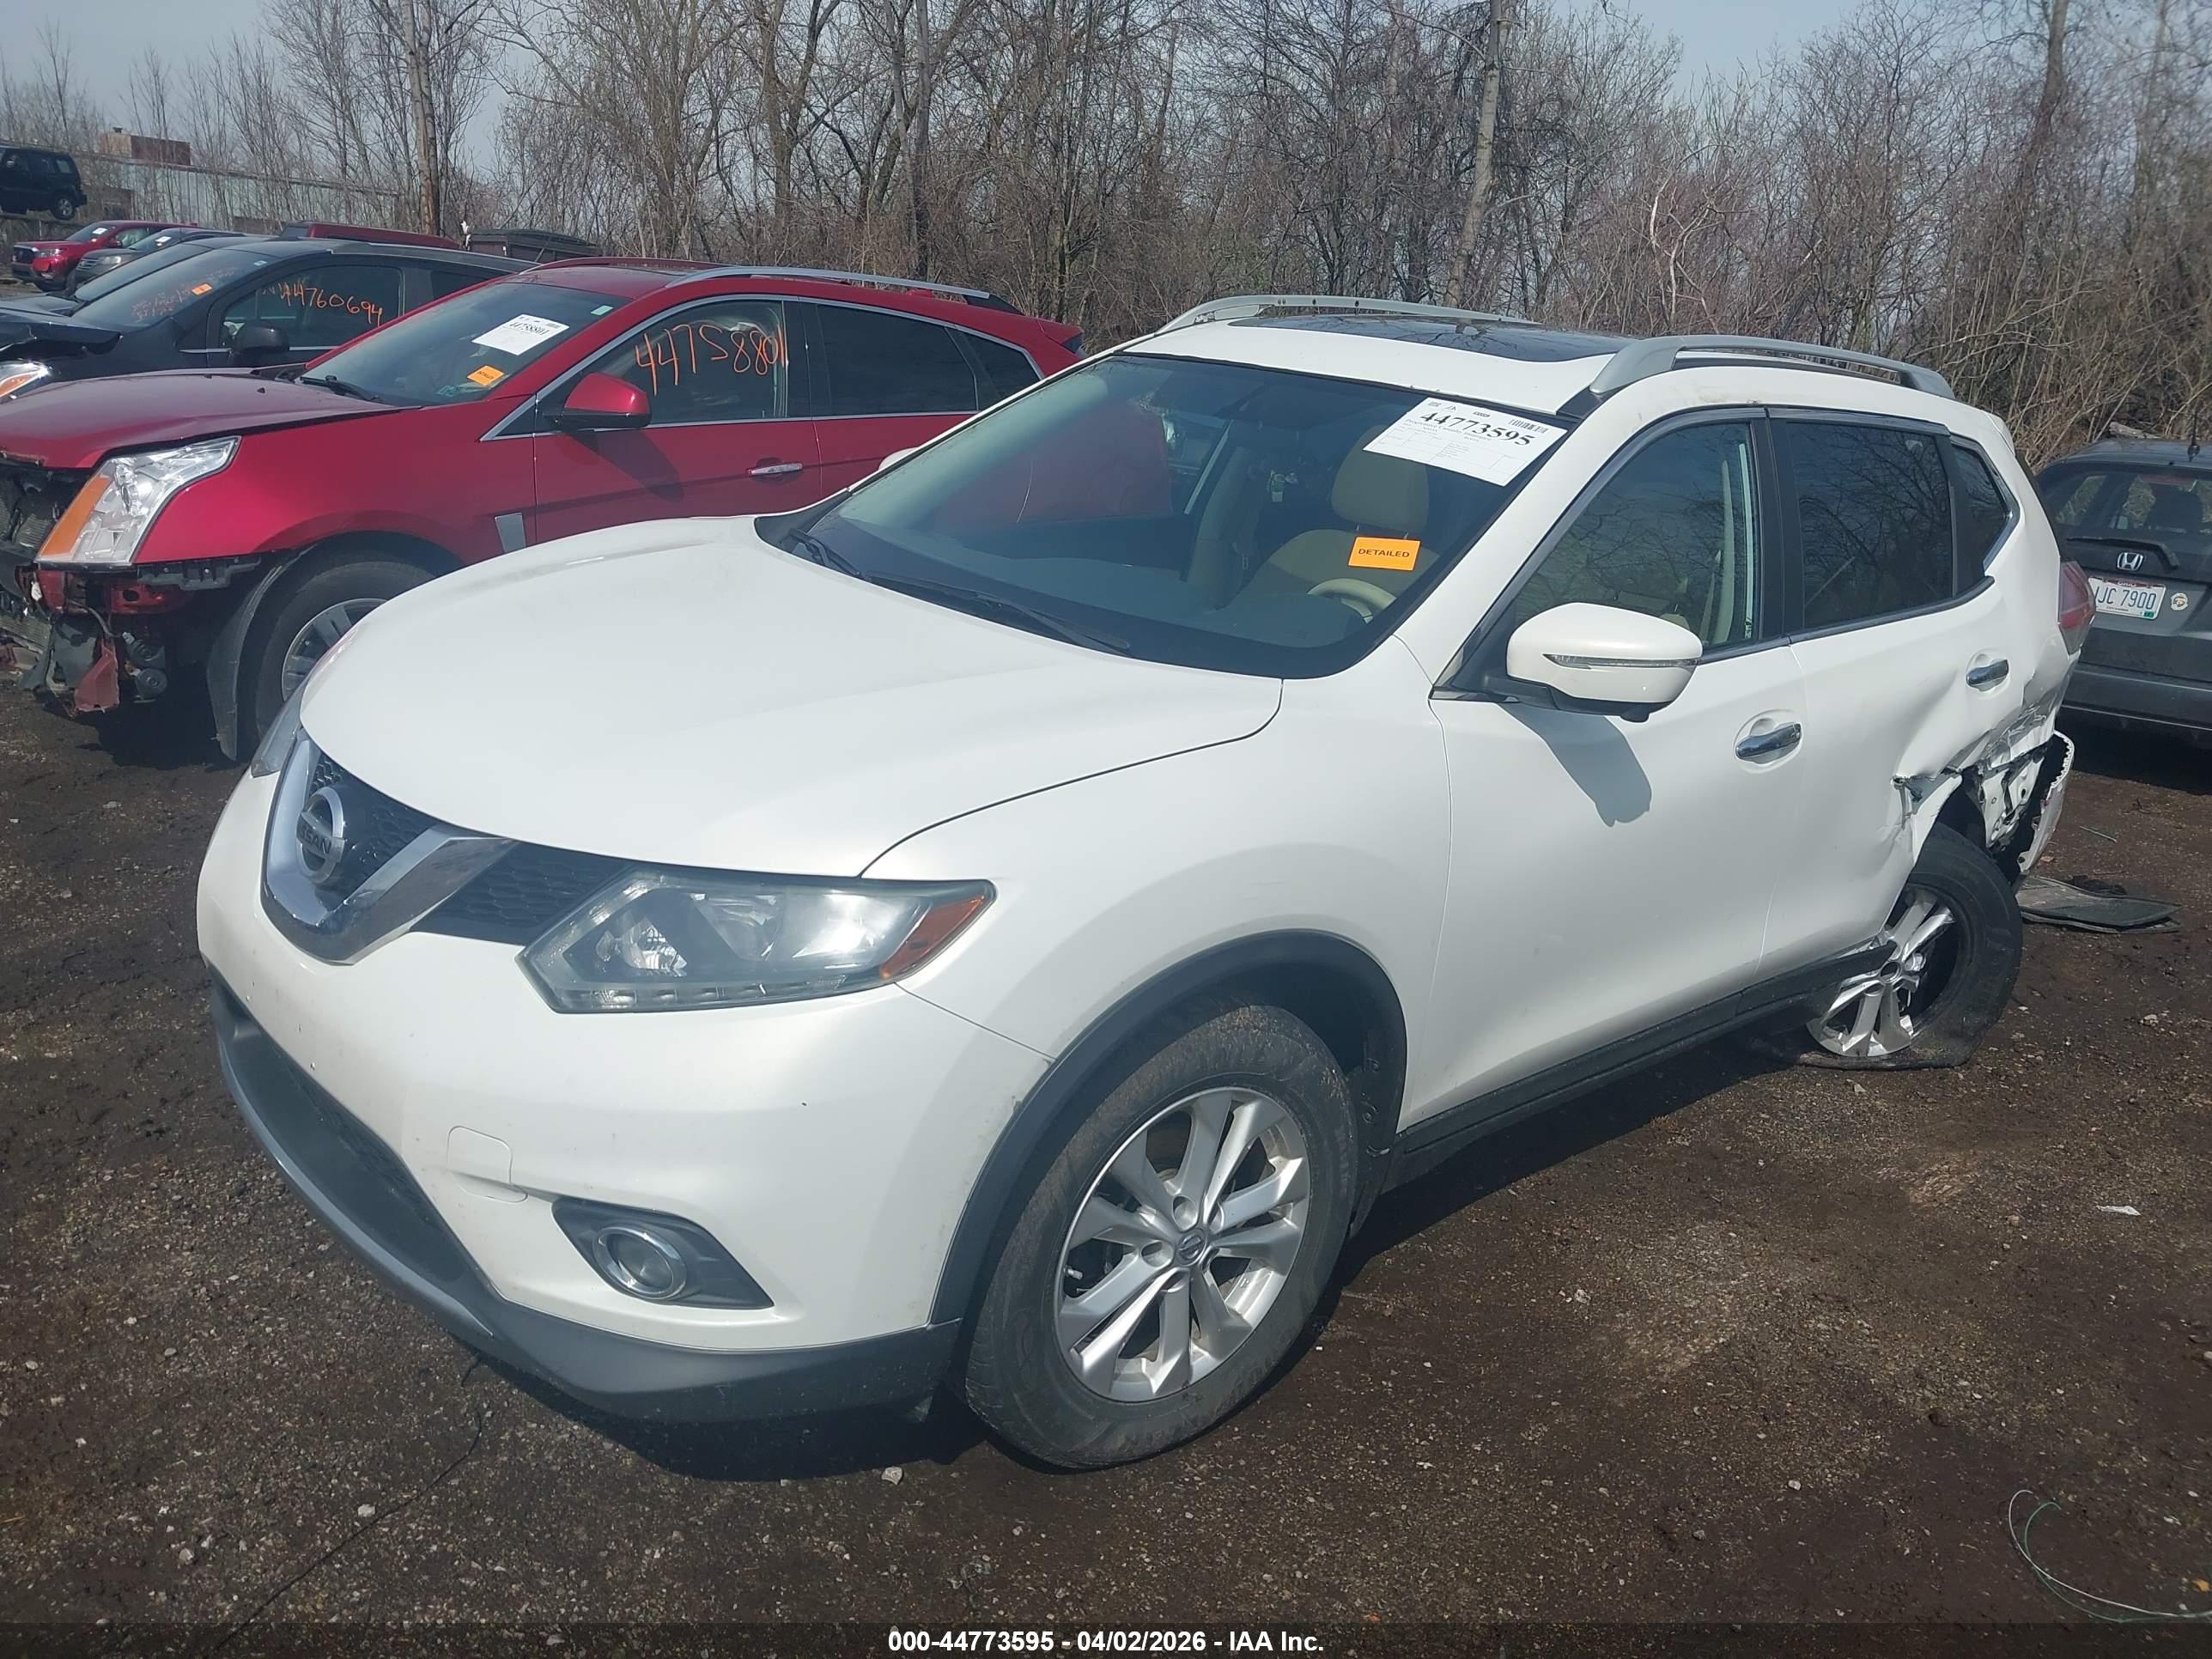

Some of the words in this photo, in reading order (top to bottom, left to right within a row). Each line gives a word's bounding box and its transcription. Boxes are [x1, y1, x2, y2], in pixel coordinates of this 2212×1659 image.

[278, 283, 383, 327] 44760694
[635, 323, 785, 396] 44758801
[1420, 411, 1536, 446] 44773595
[1358, 548, 1410, 557] DETAILED
[2122, 589, 2157, 610] 7900
